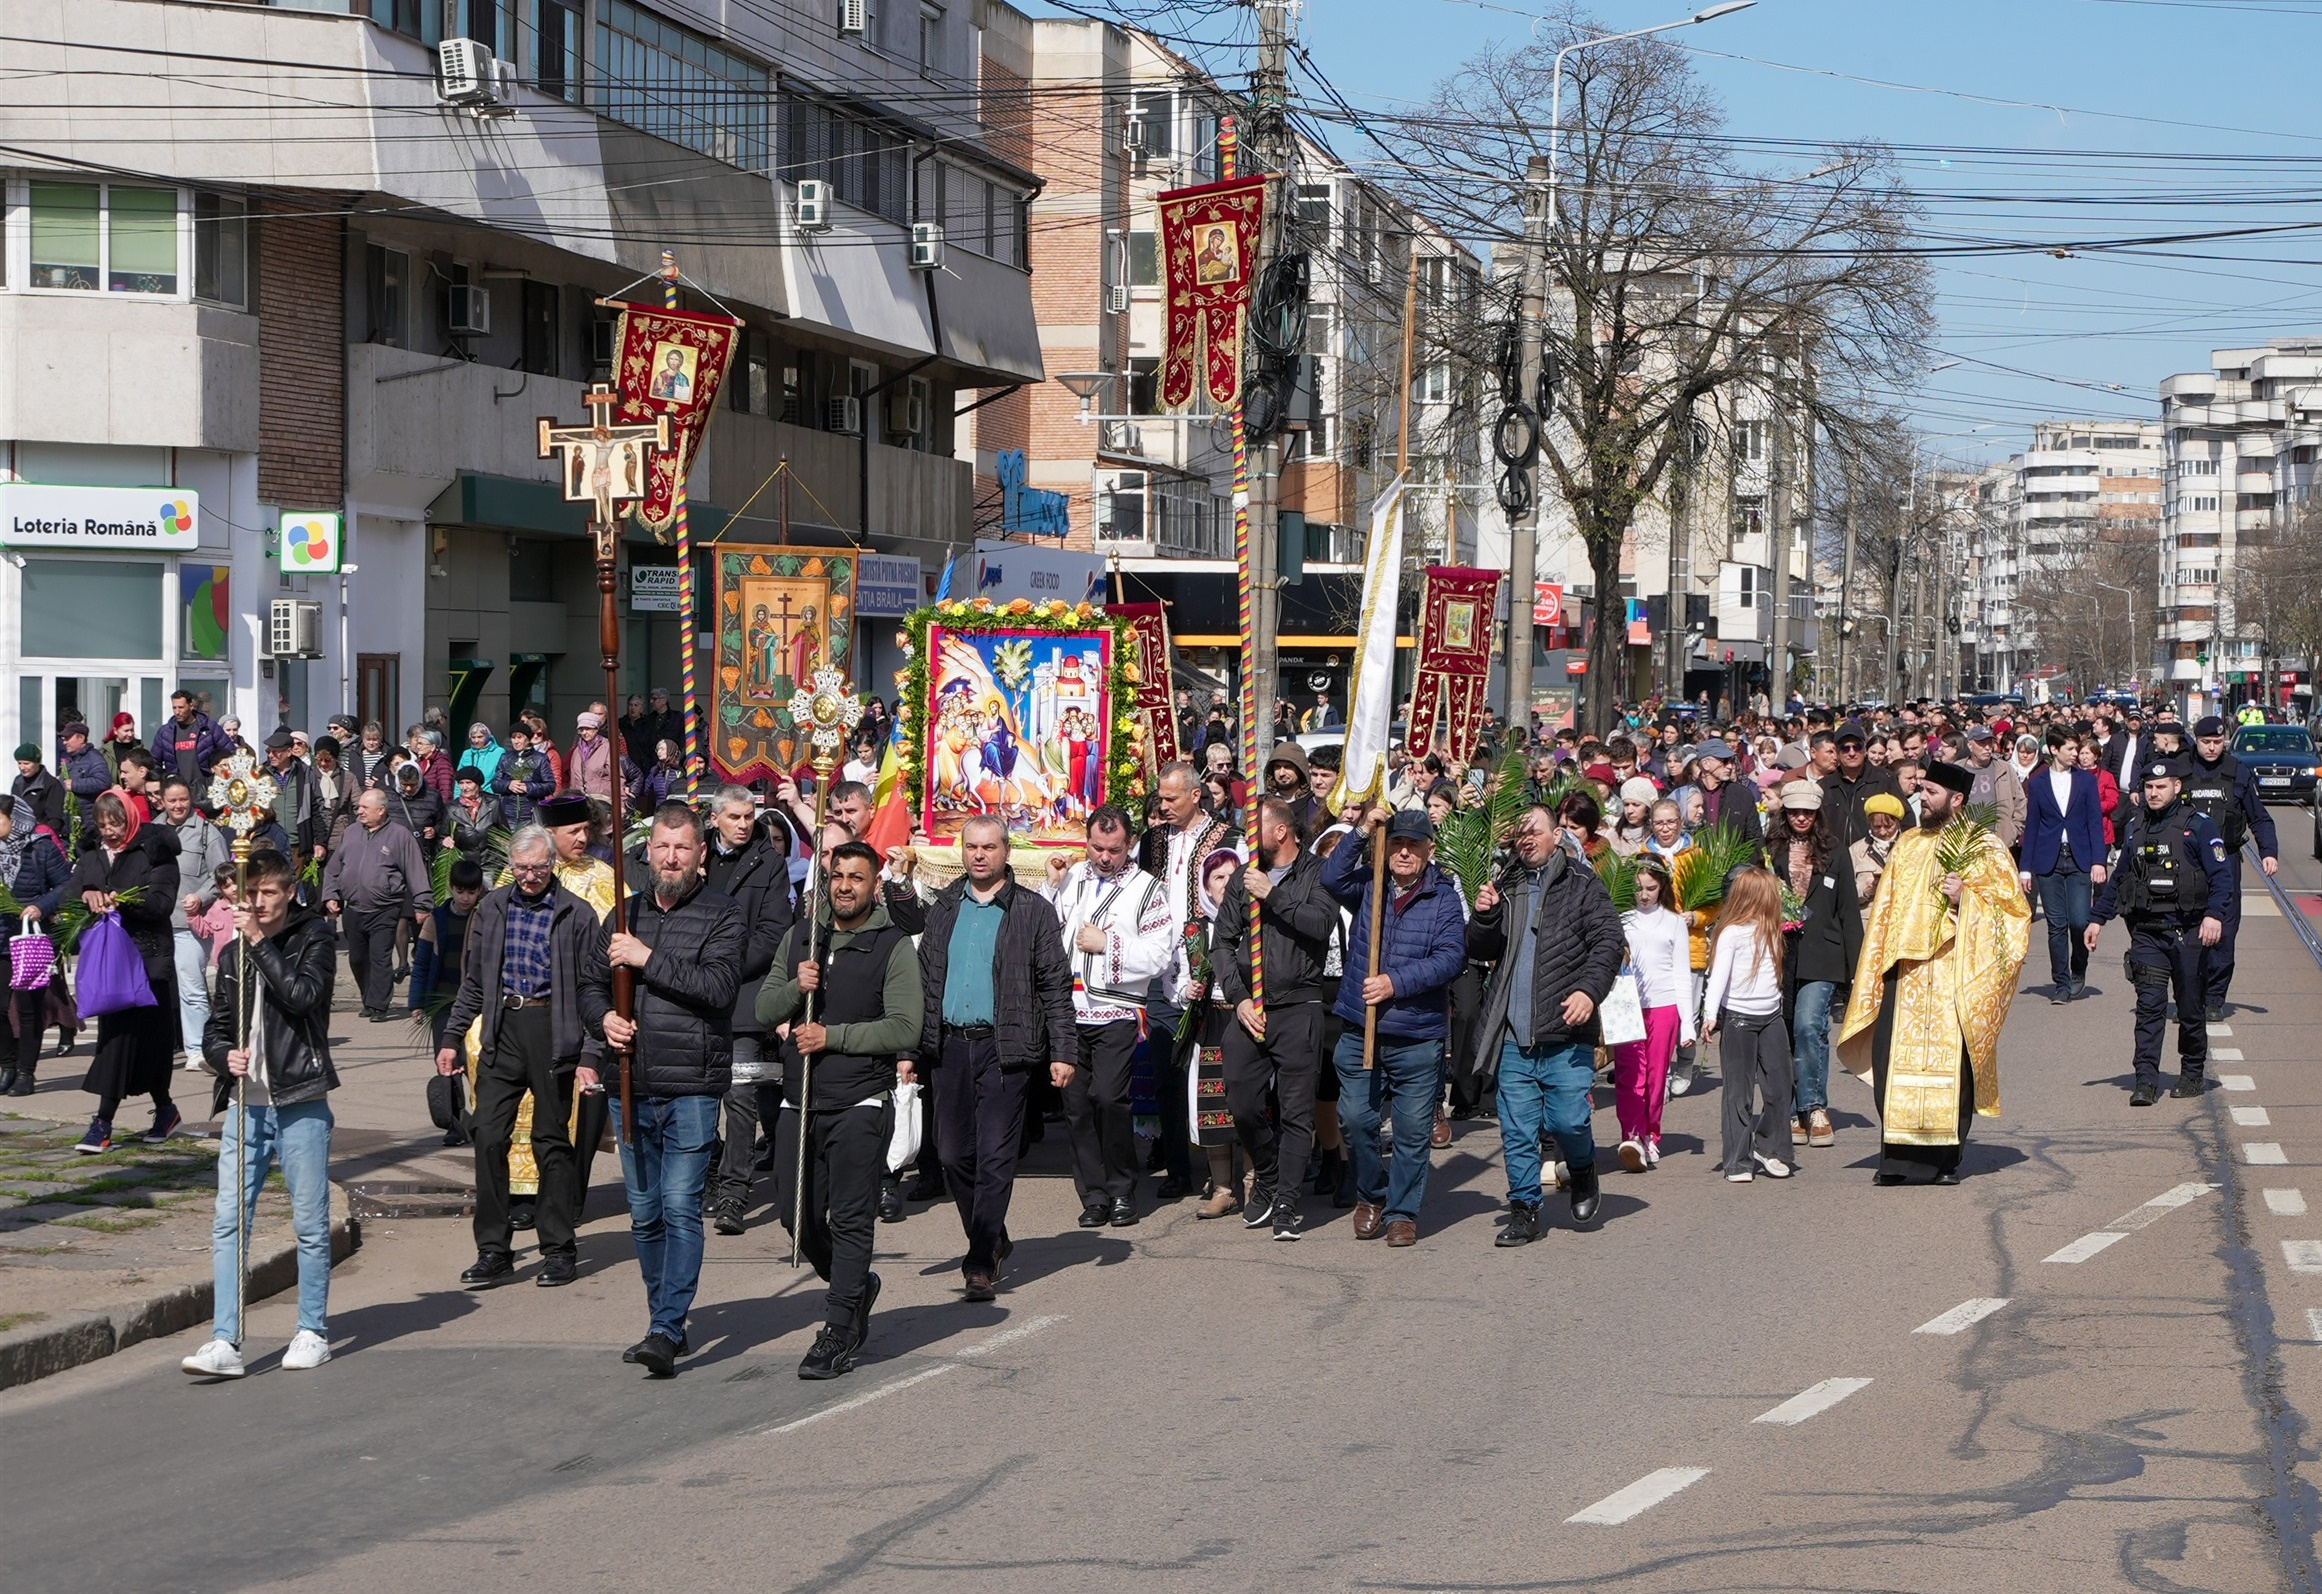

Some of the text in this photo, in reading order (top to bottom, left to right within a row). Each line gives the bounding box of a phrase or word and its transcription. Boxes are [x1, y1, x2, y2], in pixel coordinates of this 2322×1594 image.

[14, 517, 157, 537] Loteria Română
[647, 577, 676, 585] RAPID
[1030, 571, 1060, 590] GREEK FOOD
[876, 588, 903, 608] BRĂILA
